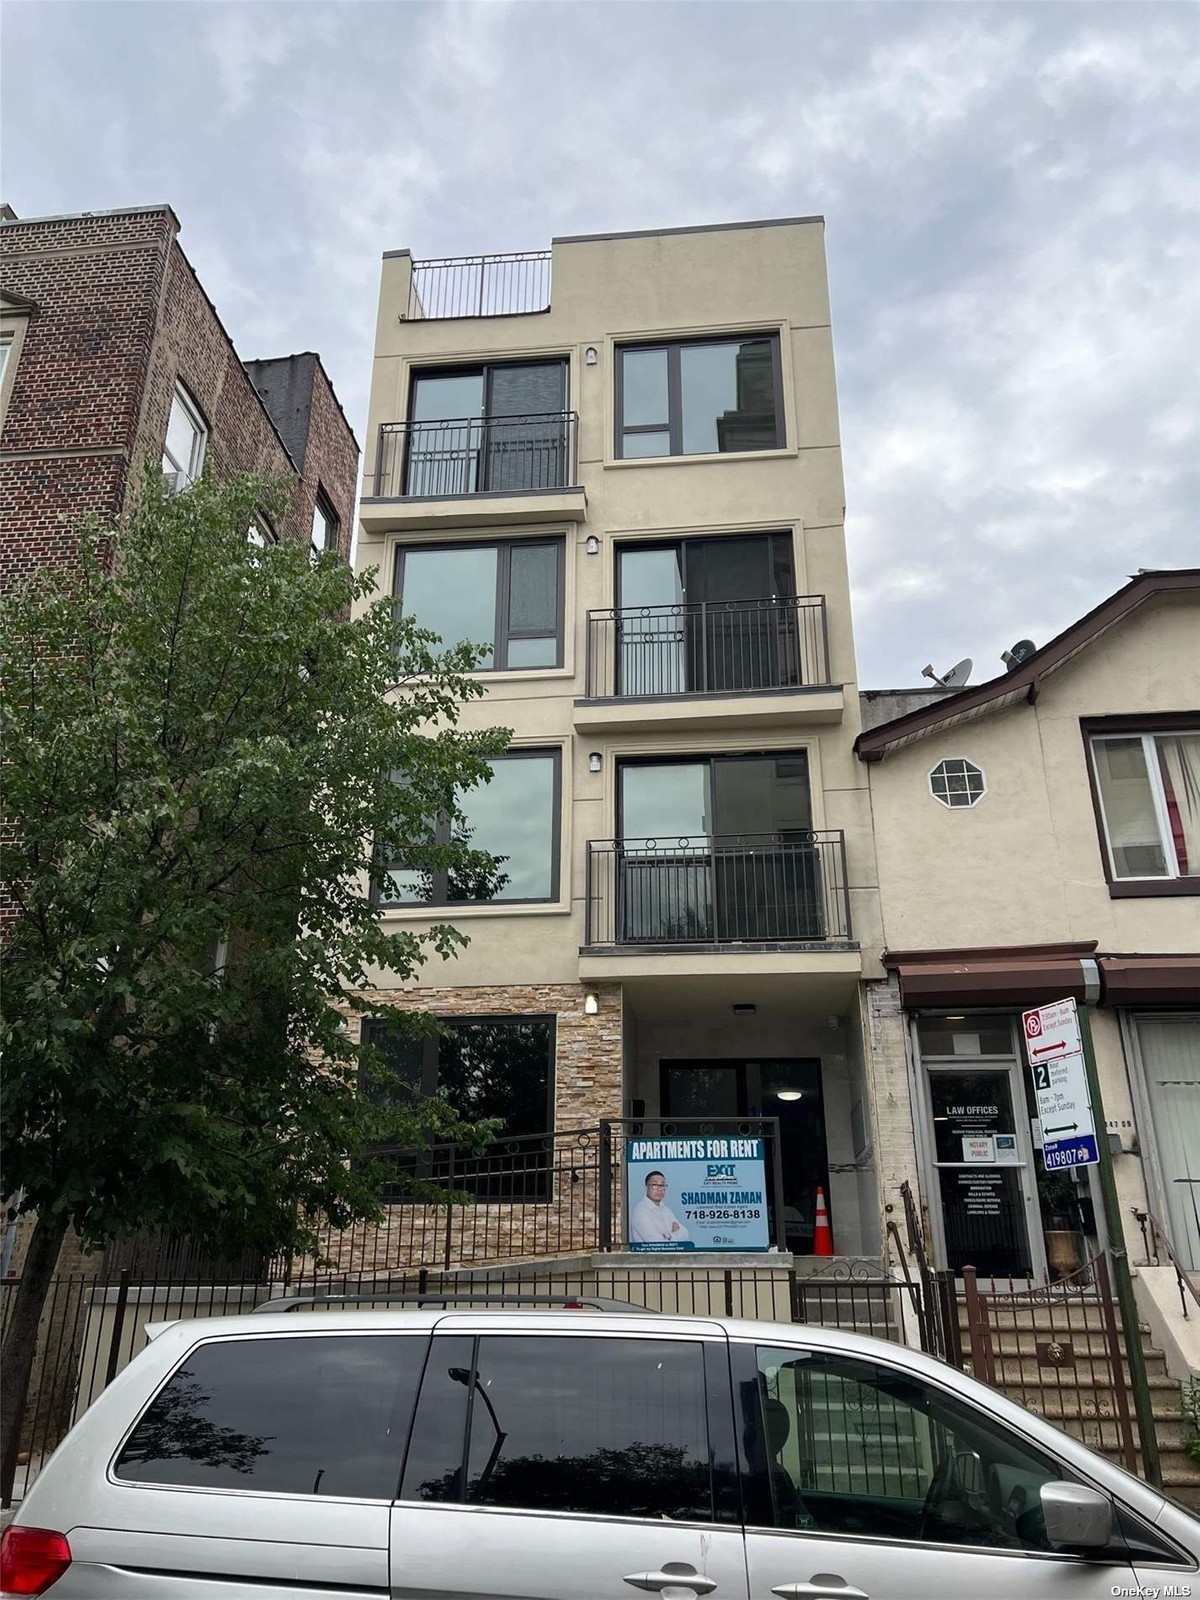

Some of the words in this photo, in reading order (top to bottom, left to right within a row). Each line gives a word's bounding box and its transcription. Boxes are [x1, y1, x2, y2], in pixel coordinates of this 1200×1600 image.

[1043, 1021, 1057, 1031] Except
[1057, 1017, 1073, 1028] Sunday
[1037, 1066, 1048, 1088] 2
[1050, 1067, 1069, 1076] metered
[1051, 1076, 1068, 1086] parking
[946, 1106, 965, 1115] LAW
[966, 1106, 999, 1115] OFFICES
[1041, 1105, 1057, 1115] Except
[1057, 1102, 1076, 1111] Sunday
[632, 1140, 705, 1160] APARTMENTS
[707, 1140, 729, 1159] FOR
[730, 1139, 759, 1158] RENT
[1046, 1149, 1077, 1167] 419807
[681, 1191, 728, 1205] SHADMAN
[729, 1191, 762, 1204] ZAMAN
[685, 1209, 761, 1219] 718-926-8138
